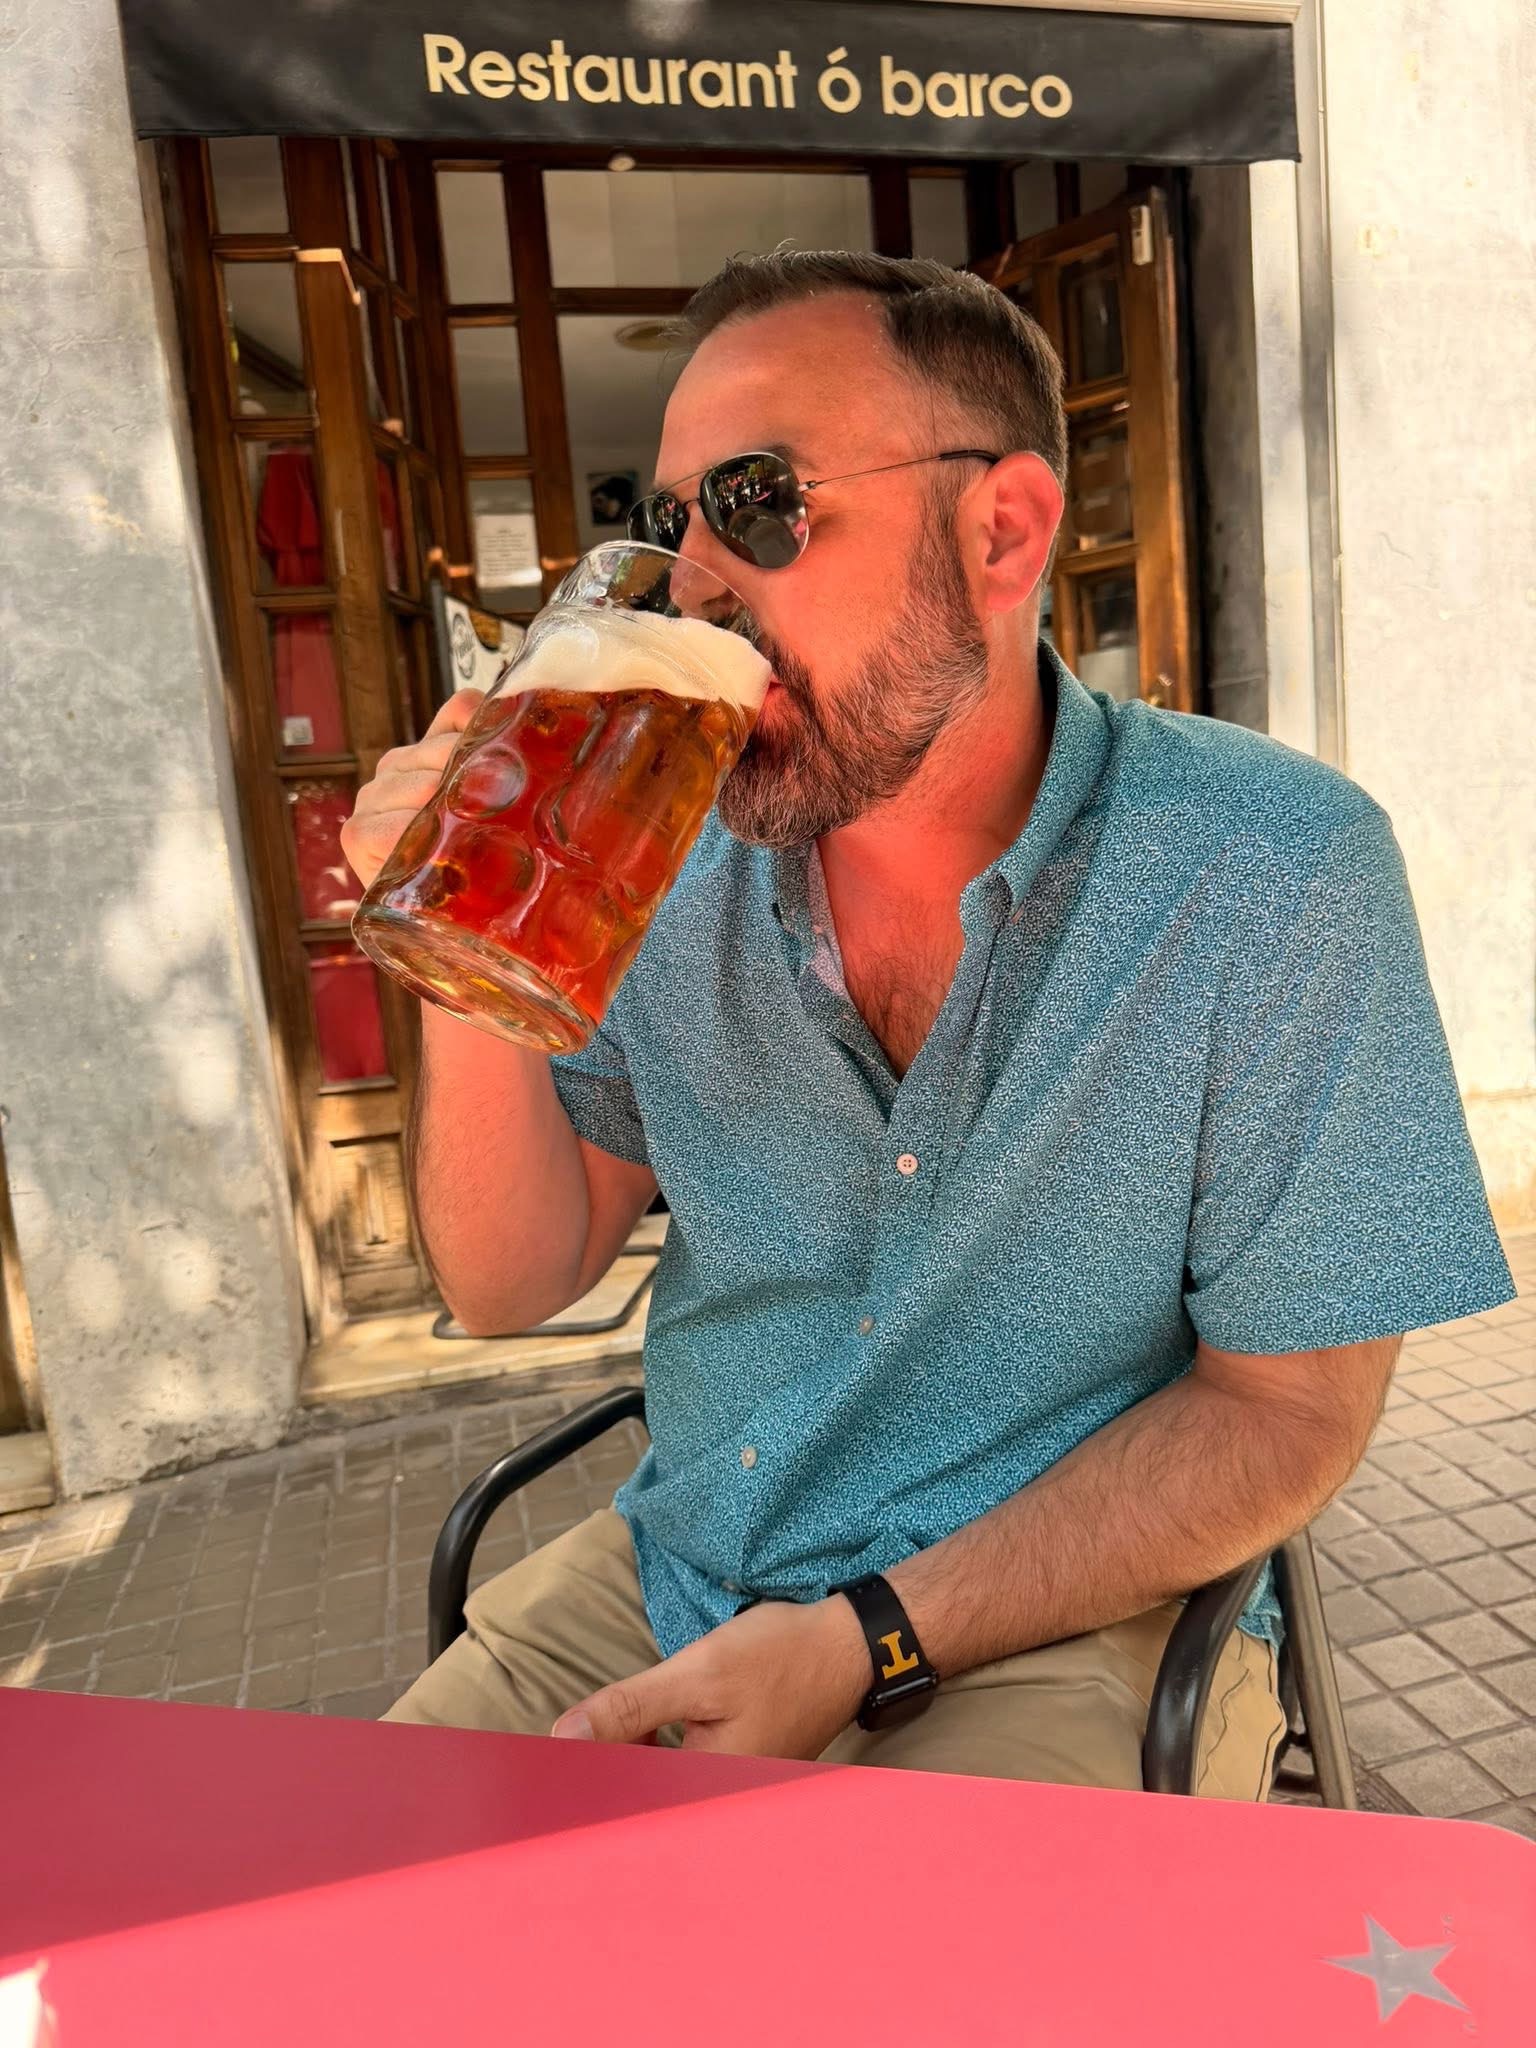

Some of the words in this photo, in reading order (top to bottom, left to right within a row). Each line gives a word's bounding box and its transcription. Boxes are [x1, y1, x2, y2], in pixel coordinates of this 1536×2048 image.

[423, 33, 798, 109] Restaurant
[818, 47, 862, 113] ó
[881, 55, 1073, 119] barco
[879, 1630, 919, 1680] T
